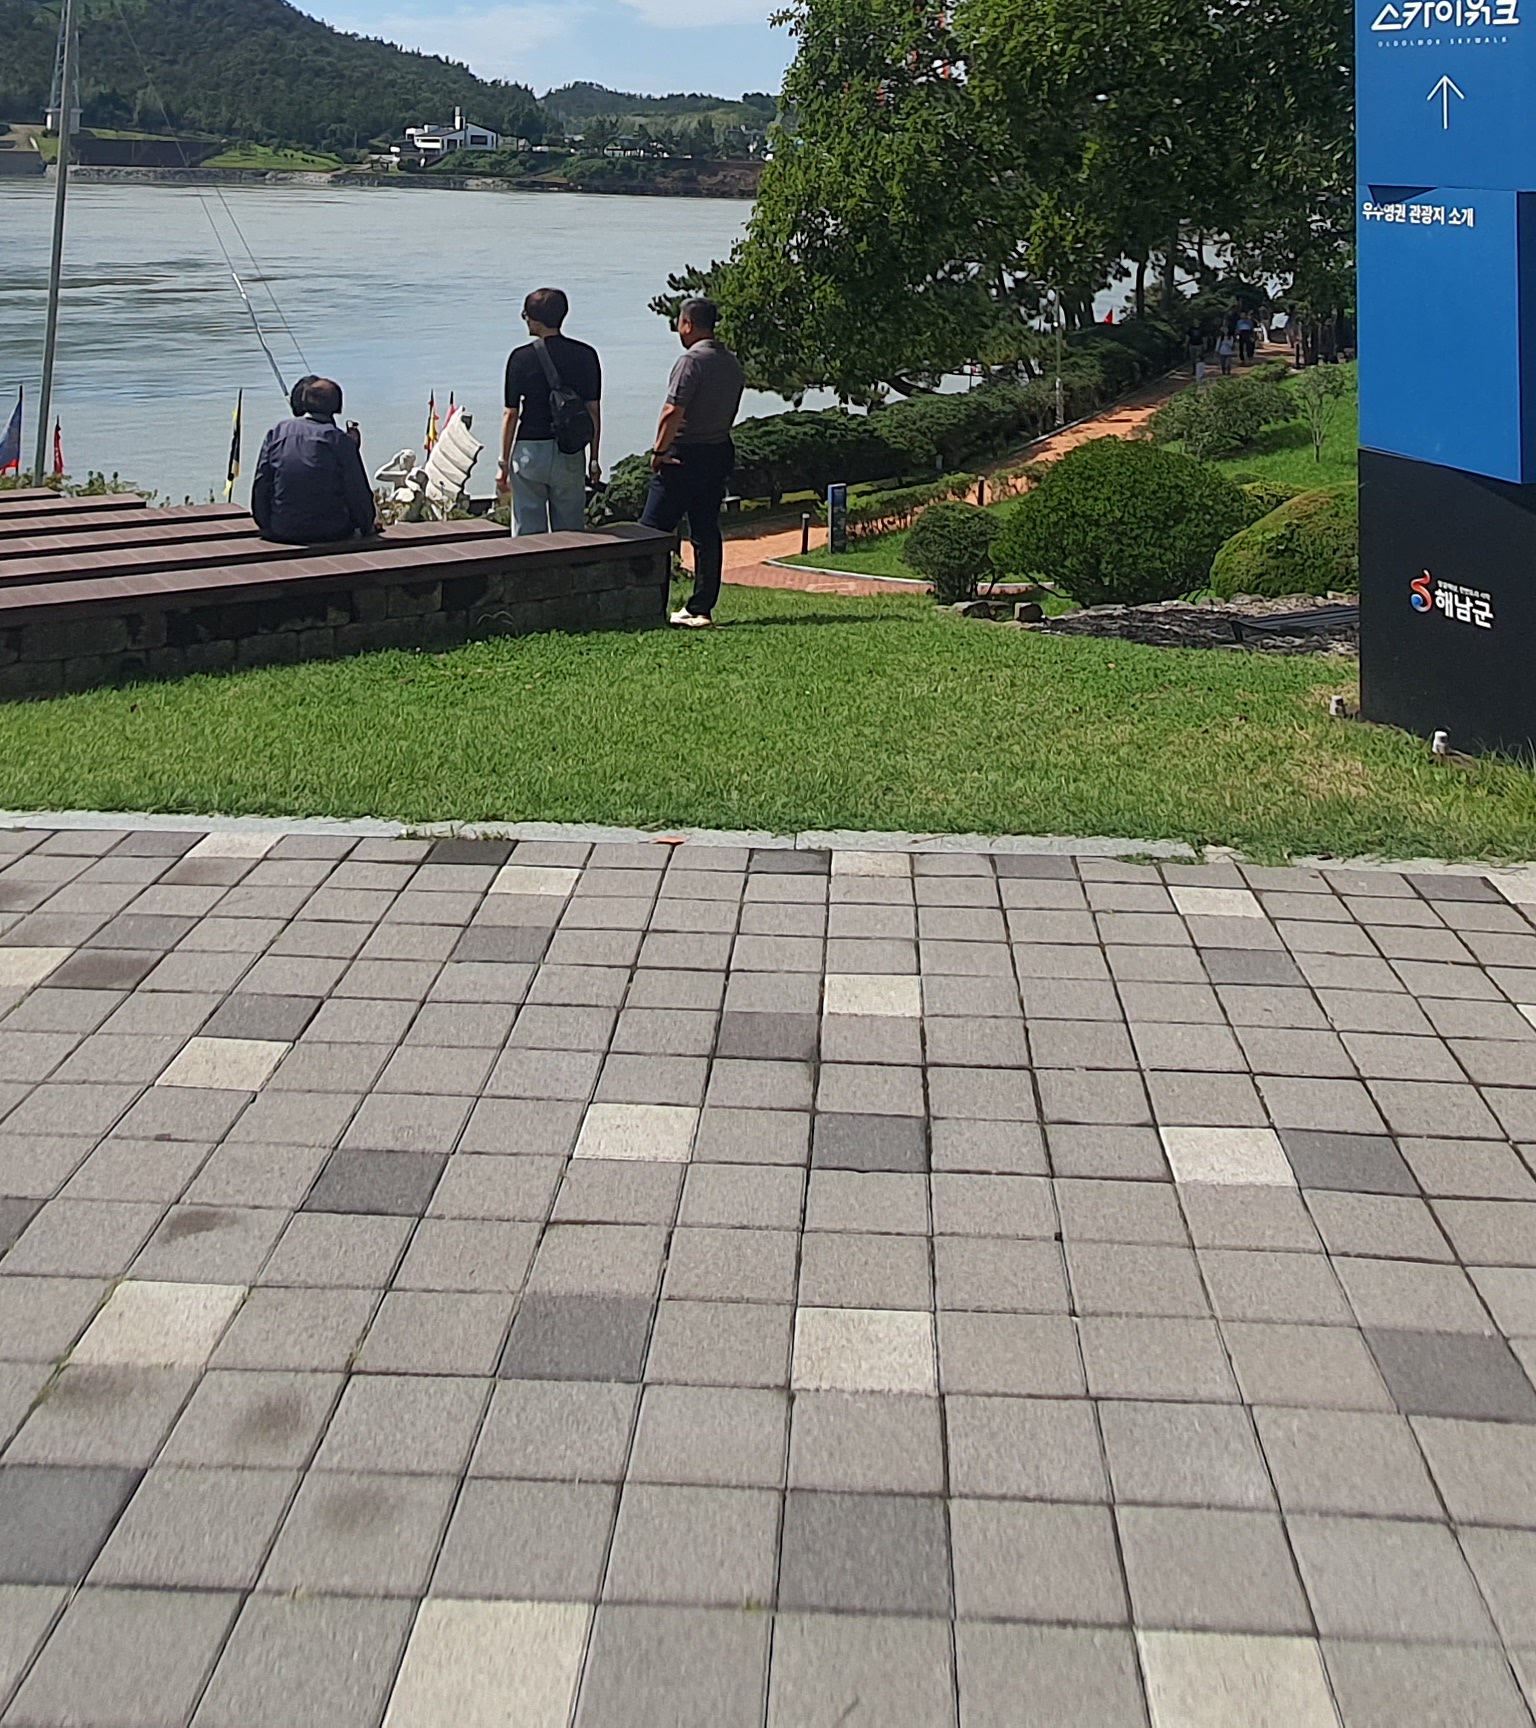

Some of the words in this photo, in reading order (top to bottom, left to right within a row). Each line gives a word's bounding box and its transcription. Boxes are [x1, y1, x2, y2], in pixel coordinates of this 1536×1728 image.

[1362, 201, 1406, 223] 우수영권
[1409, 204, 1445, 225] 관광지
[1448, 207, 1474, 228] 소개
[1434, 588, 1494, 628] 해남군
